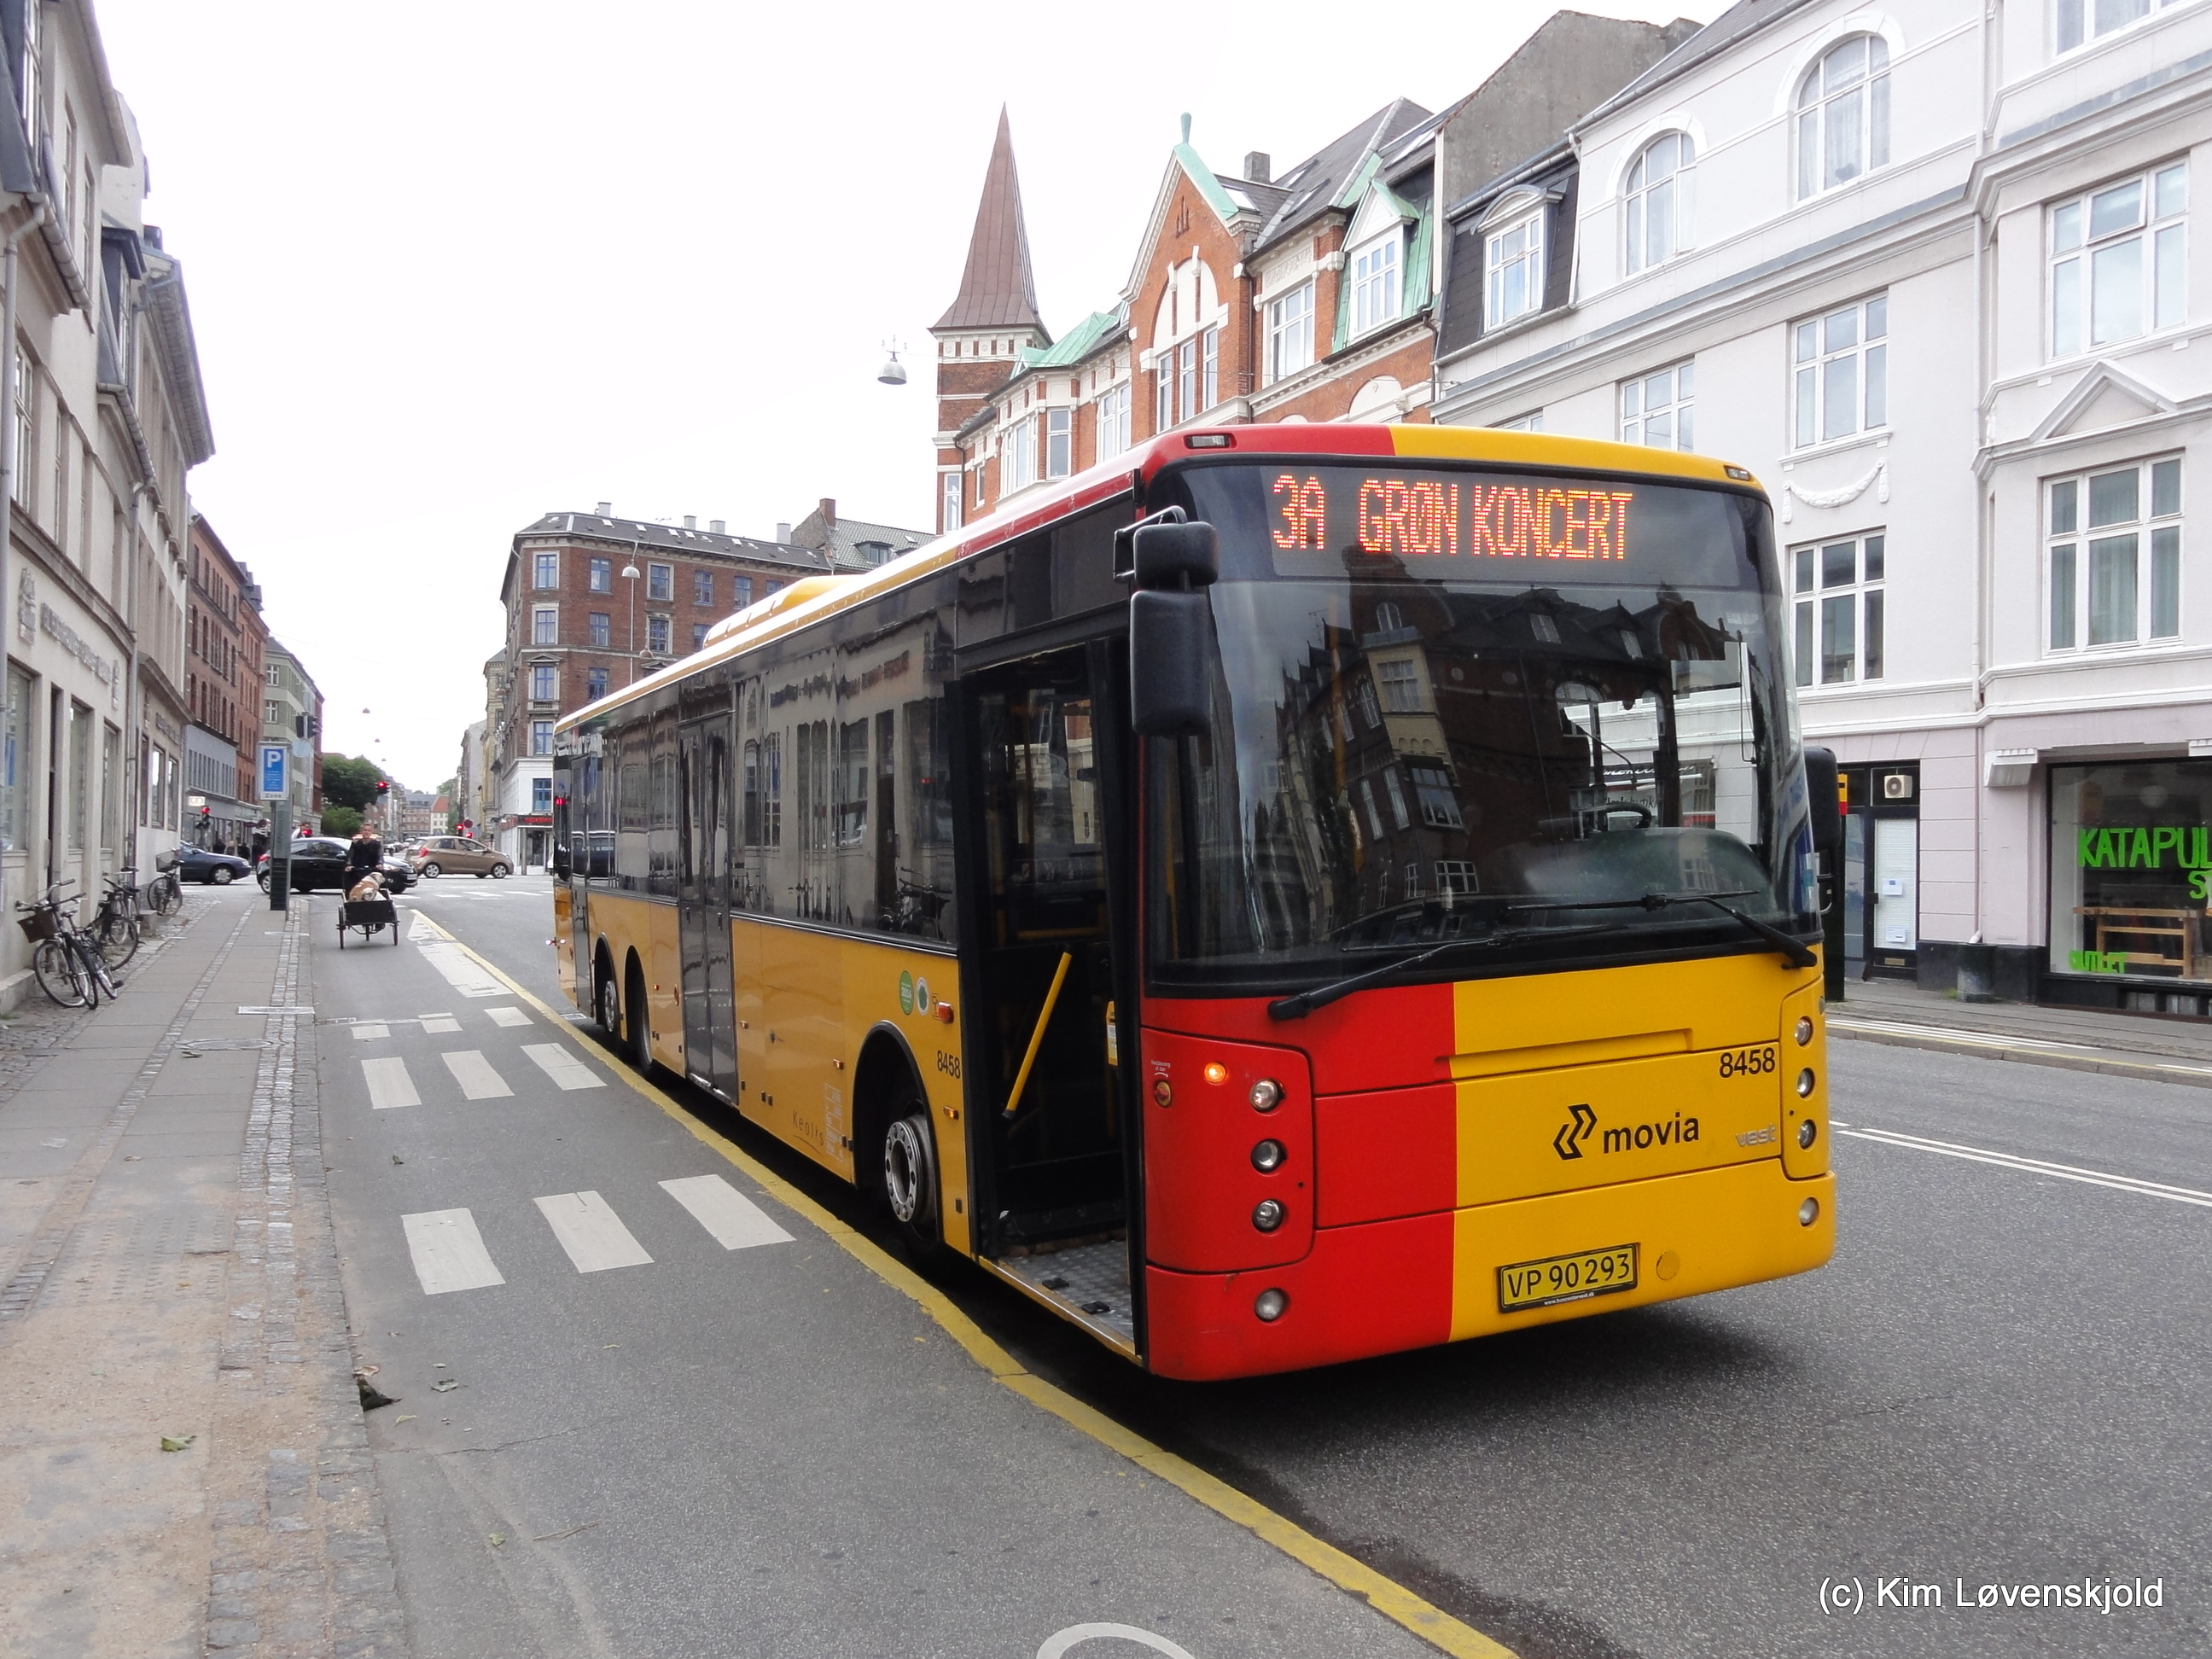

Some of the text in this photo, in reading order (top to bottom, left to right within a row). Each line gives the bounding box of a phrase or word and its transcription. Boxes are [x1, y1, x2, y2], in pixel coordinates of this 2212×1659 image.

[1273, 474, 1633, 560] 3A GRØN KONCERT
[267, 751, 281, 768] P
[2068, 950, 2126, 974] OUTLET
[937, 1050, 961, 1079] 8458
[1719, 1047, 1776, 1078] 8458
[793, 1109, 824, 1146] Keolis
[1604, 1111, 1699, 1154] movia
[1735, 1122, 1777, 1147] vest
[1507, 1269, 1541, 1298] VP
